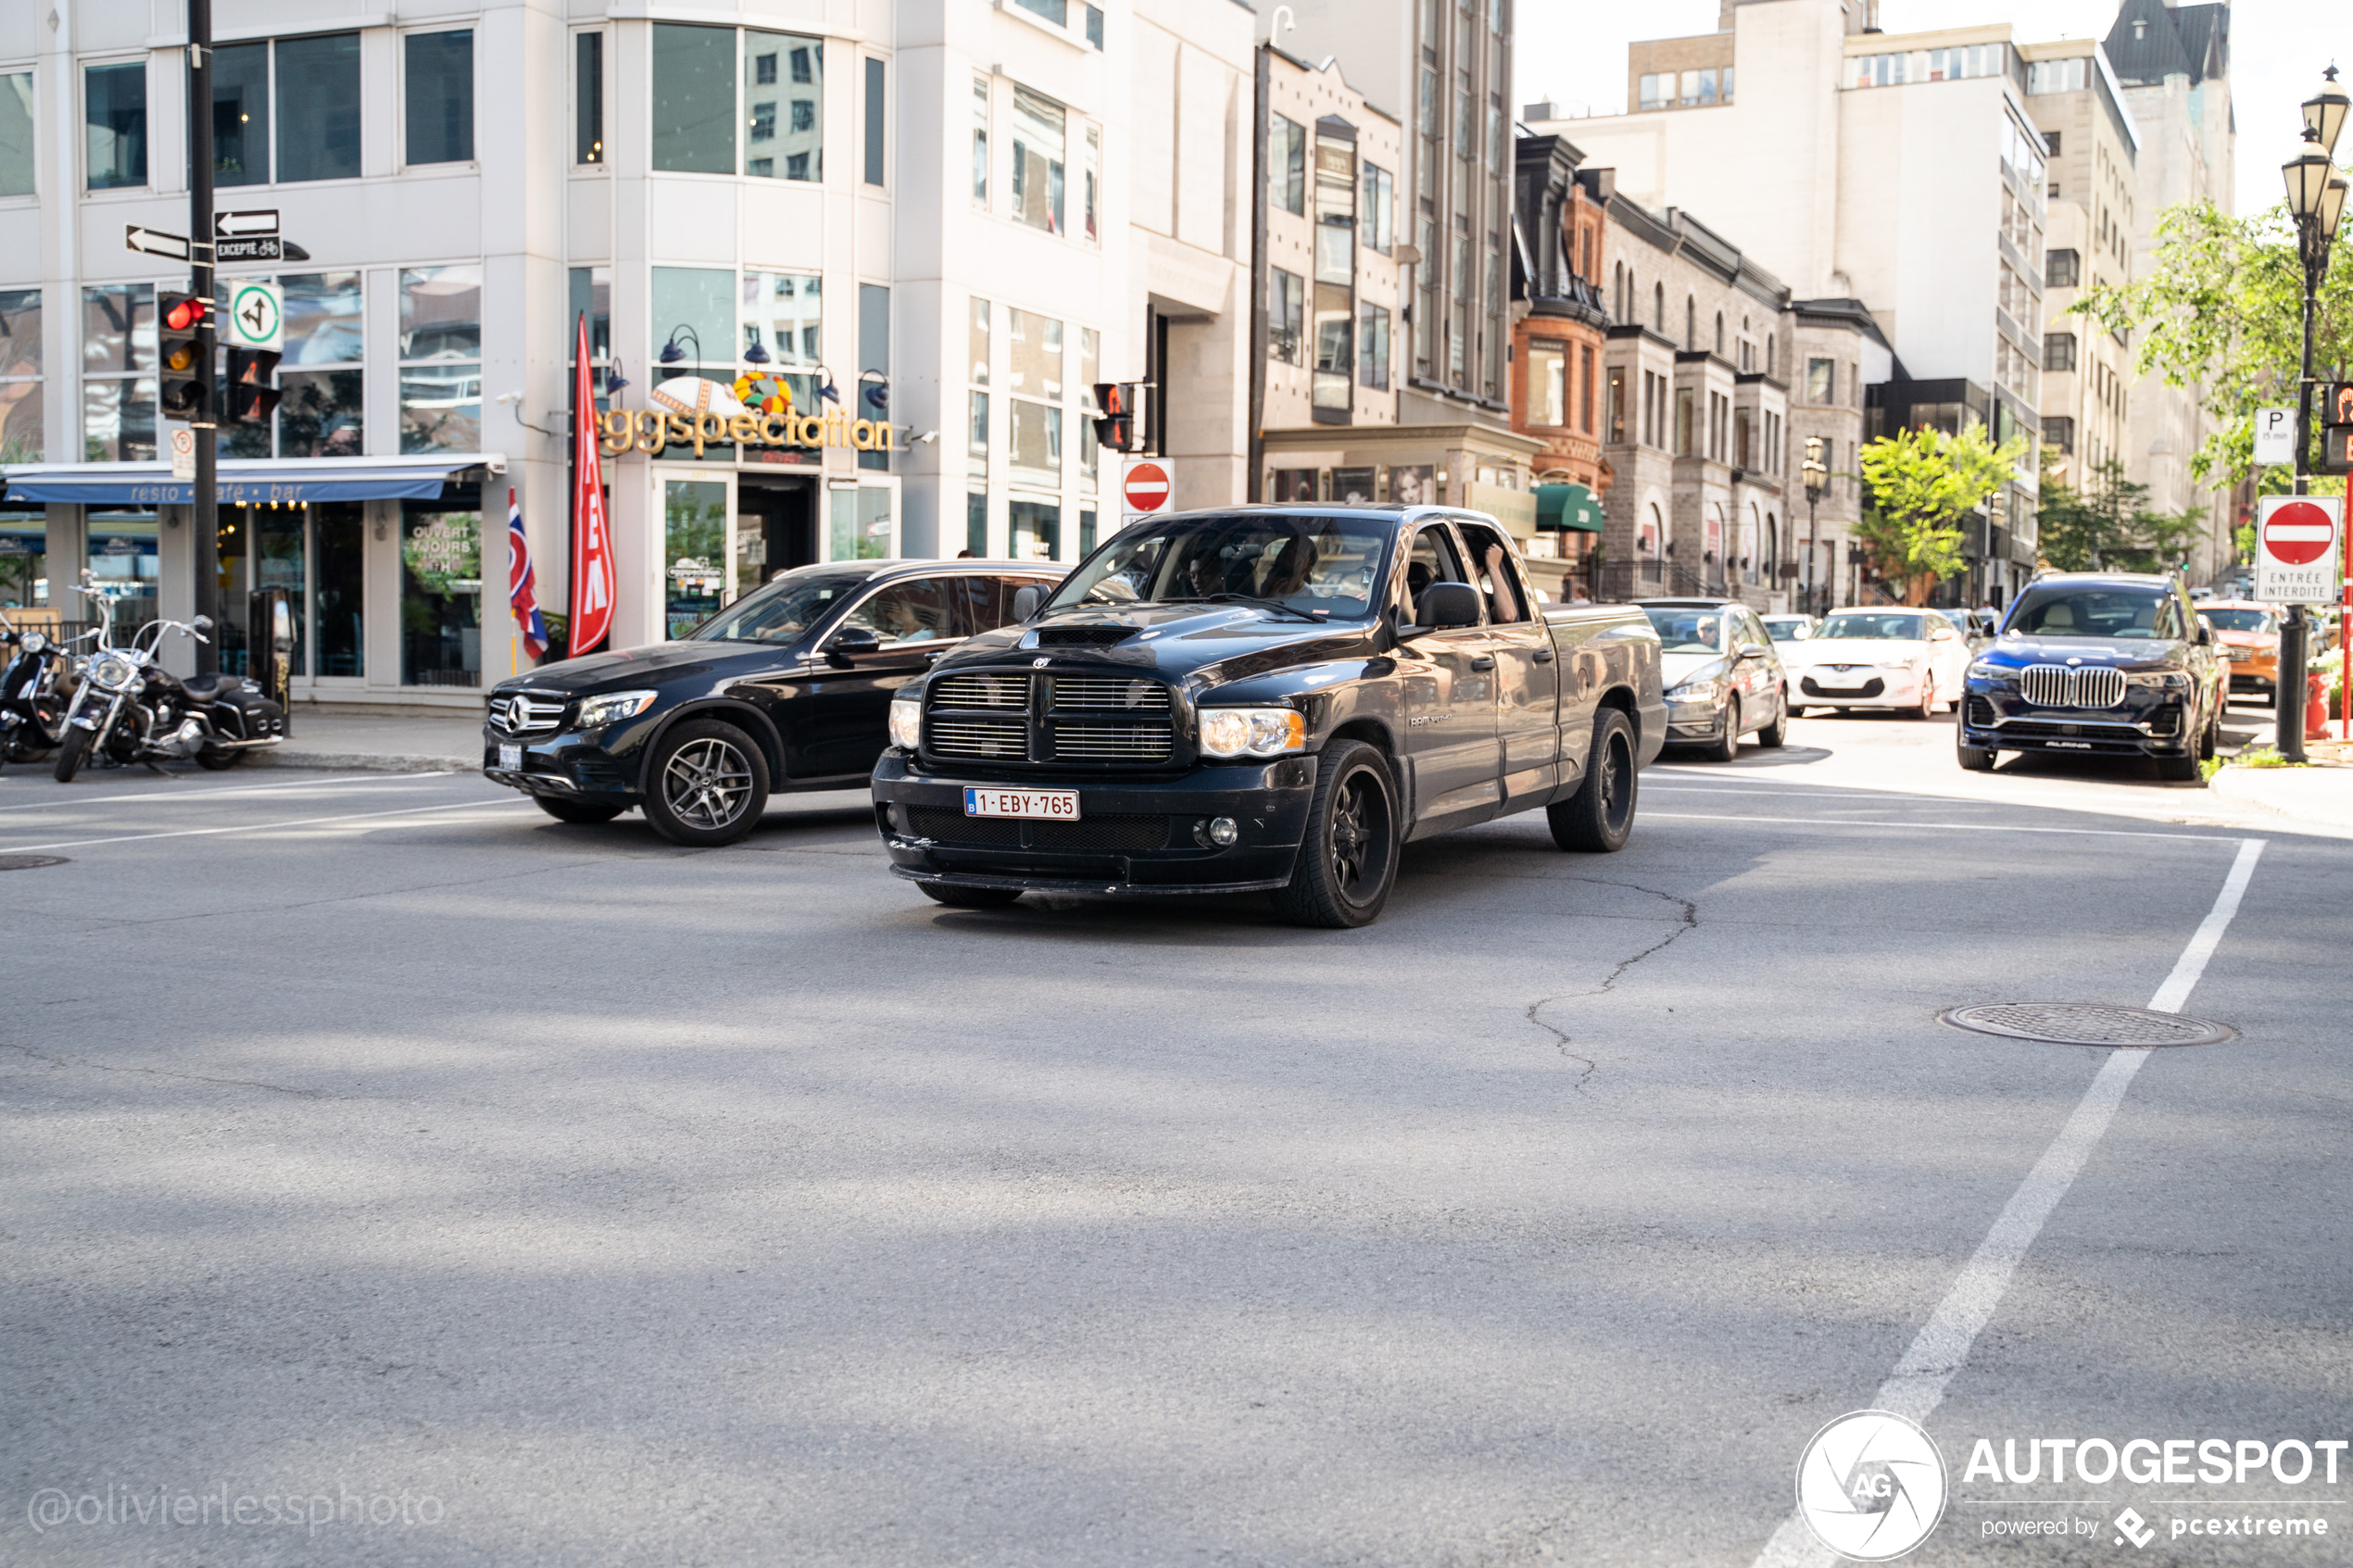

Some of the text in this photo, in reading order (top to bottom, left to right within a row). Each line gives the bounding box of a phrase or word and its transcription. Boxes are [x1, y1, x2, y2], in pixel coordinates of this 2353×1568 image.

[2269, 412, 2284, 431] P
[596, 405, 894, 457] ggspectation
[131, 483, 303, 501] resto afé bar
[412, 526, 470, 538] OUVERT
[422, 541, 471, 553] JOURS
[2271, 571, 2322, 583] ENTRÉE
[2264, 587, 2325, 597] INTERDITE
[968, 803, 975, 812] B
[980, 794, 1074, 814] 1-EBY-765
